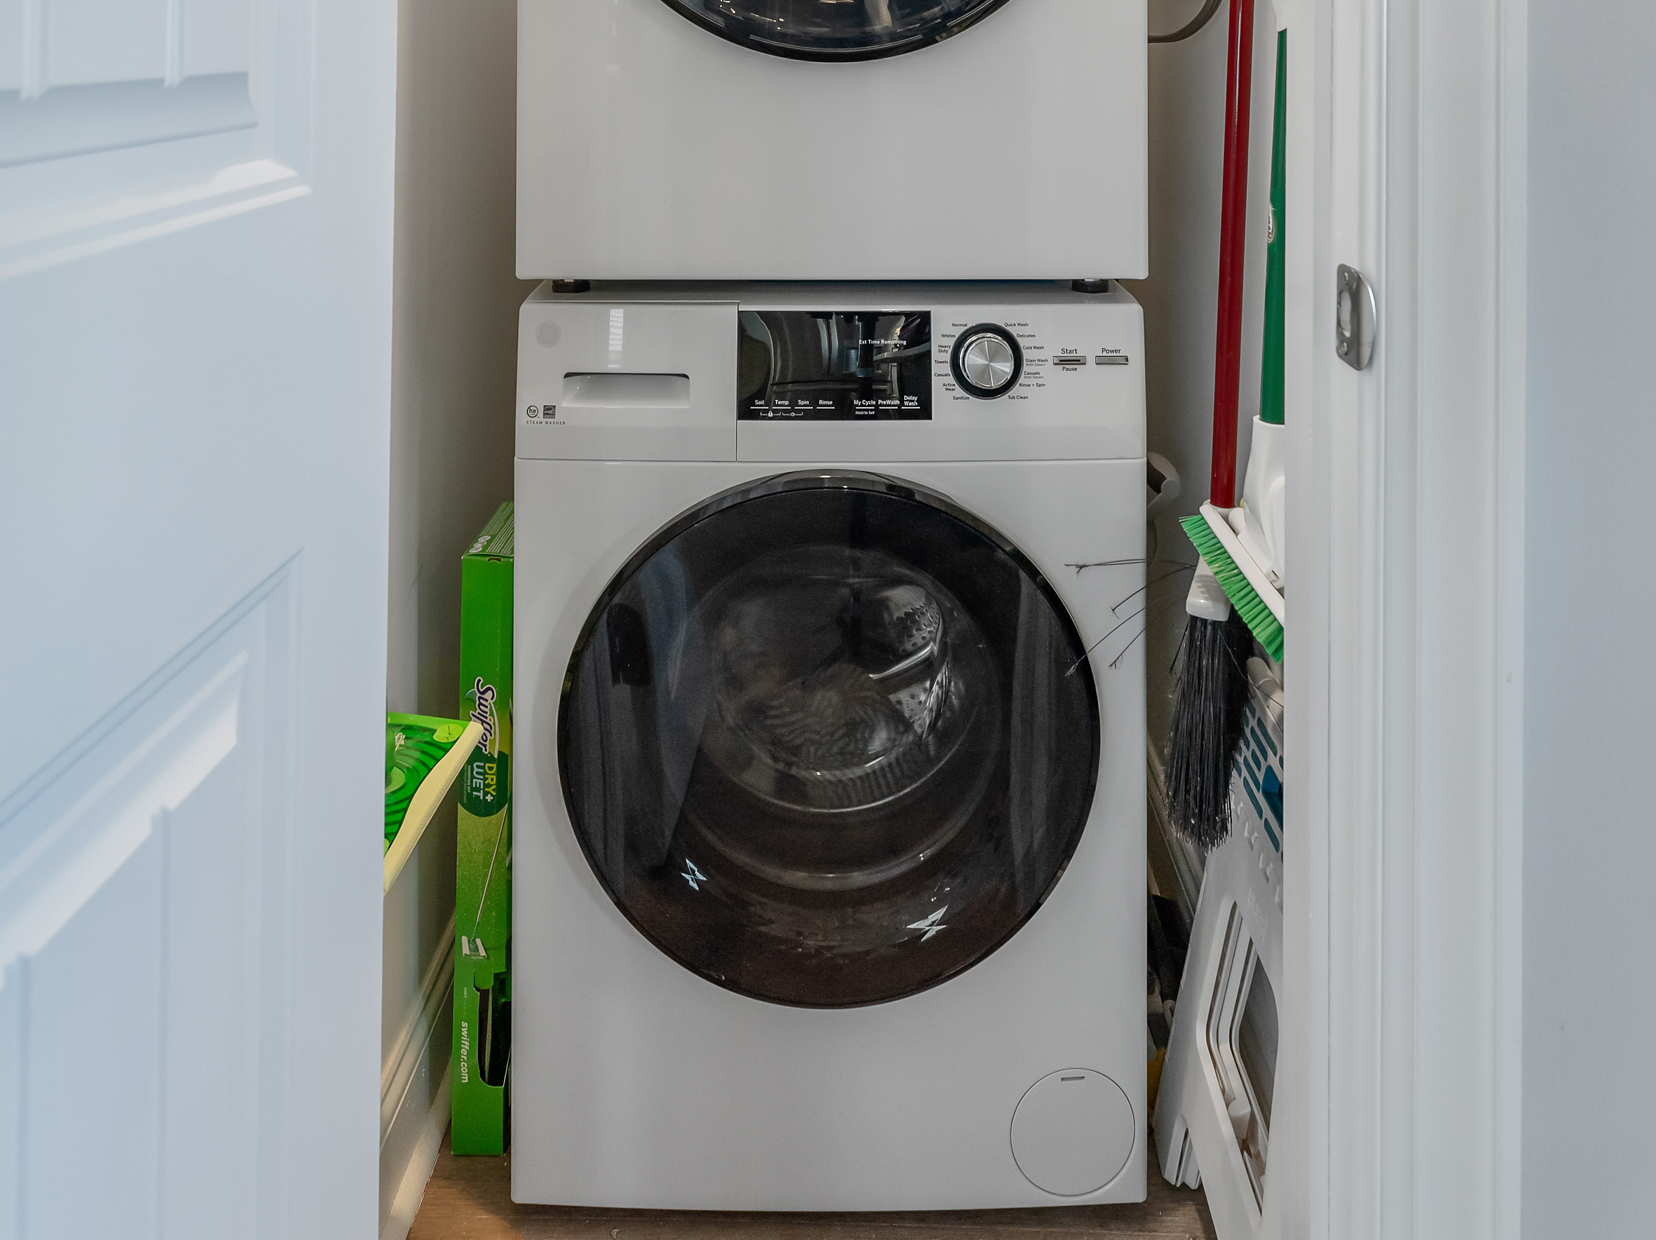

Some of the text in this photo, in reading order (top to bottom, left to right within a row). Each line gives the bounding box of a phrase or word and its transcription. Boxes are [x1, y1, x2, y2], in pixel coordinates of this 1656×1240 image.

[1060, 347, 1078, 355] Start
[470, 677, 497, 755] Swiffer
[472, 761, 485, 800] WET
[460, 1021, 470, 1083] swiffer.com
